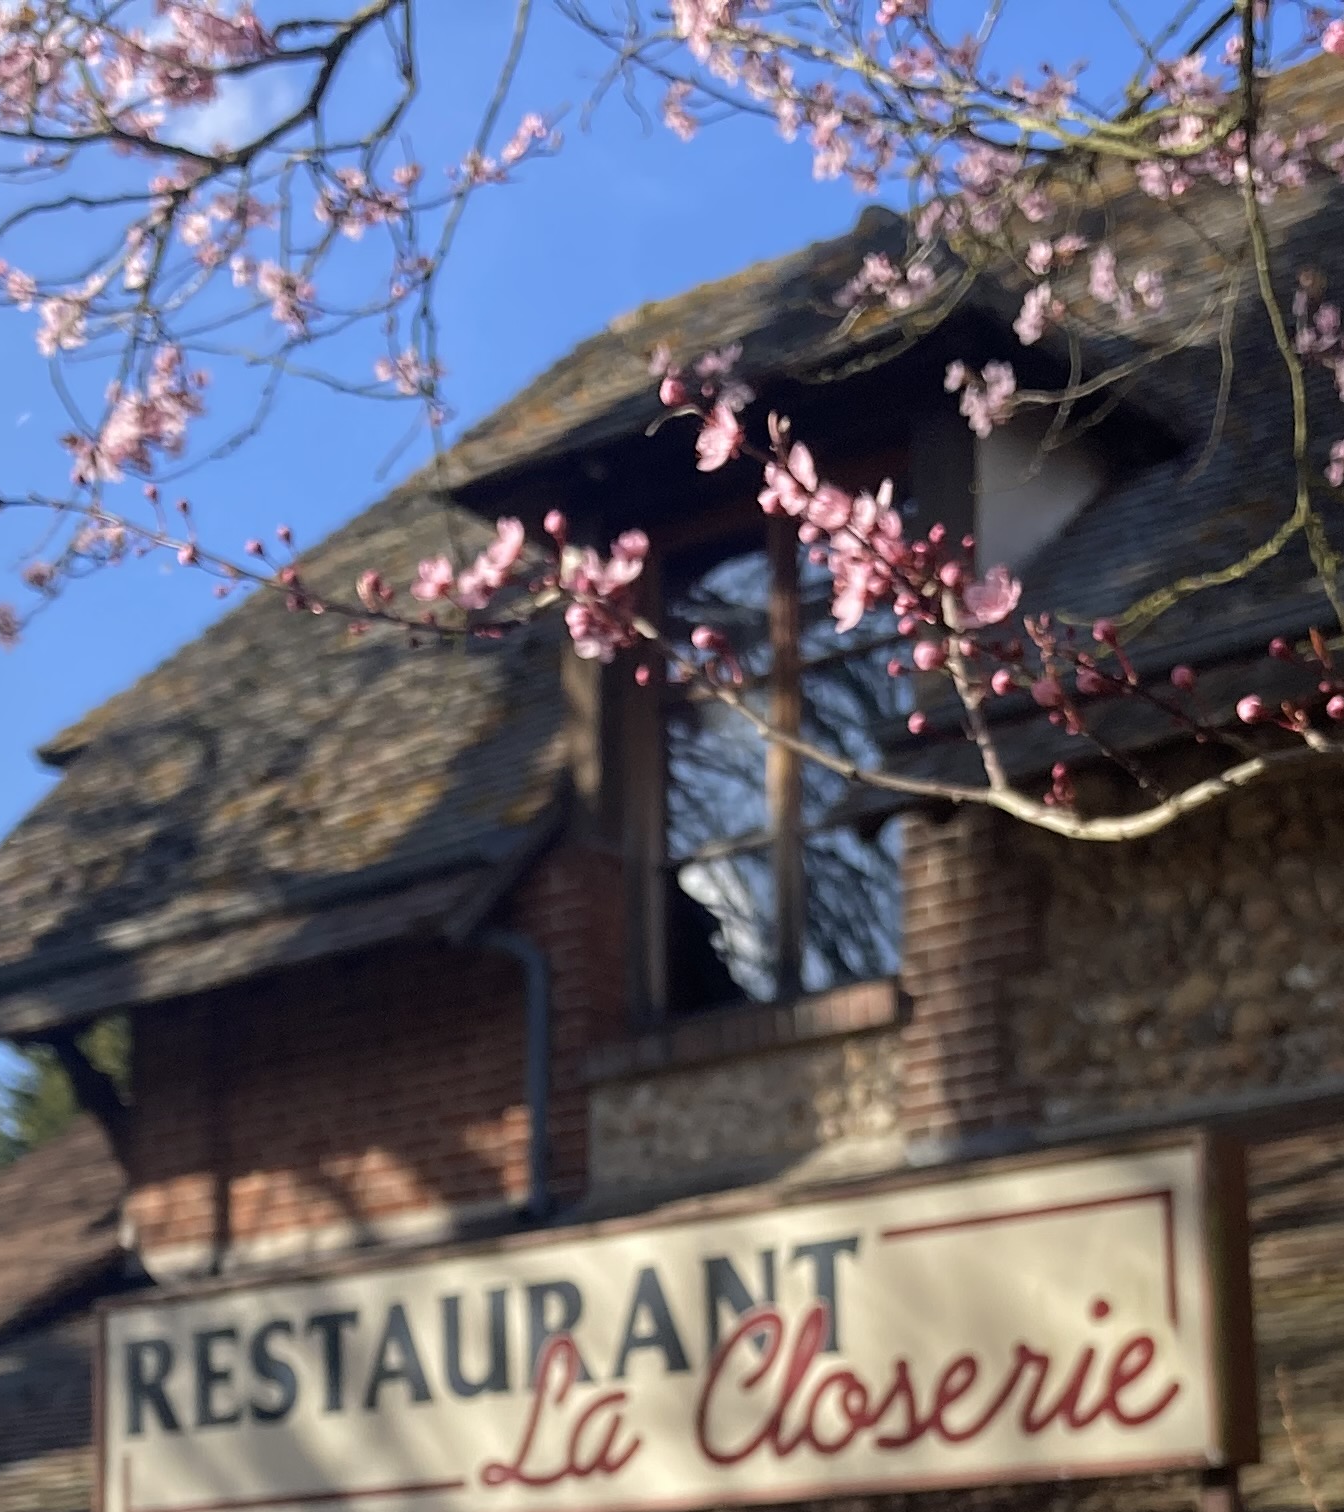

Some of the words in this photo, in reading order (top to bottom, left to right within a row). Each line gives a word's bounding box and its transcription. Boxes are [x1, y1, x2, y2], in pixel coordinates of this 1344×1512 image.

[123, 1237, 863, 1437] RESTAURANT
[482, 1332, 644, 1488] La
[696, 1298, 1179, 1468] Closerie
